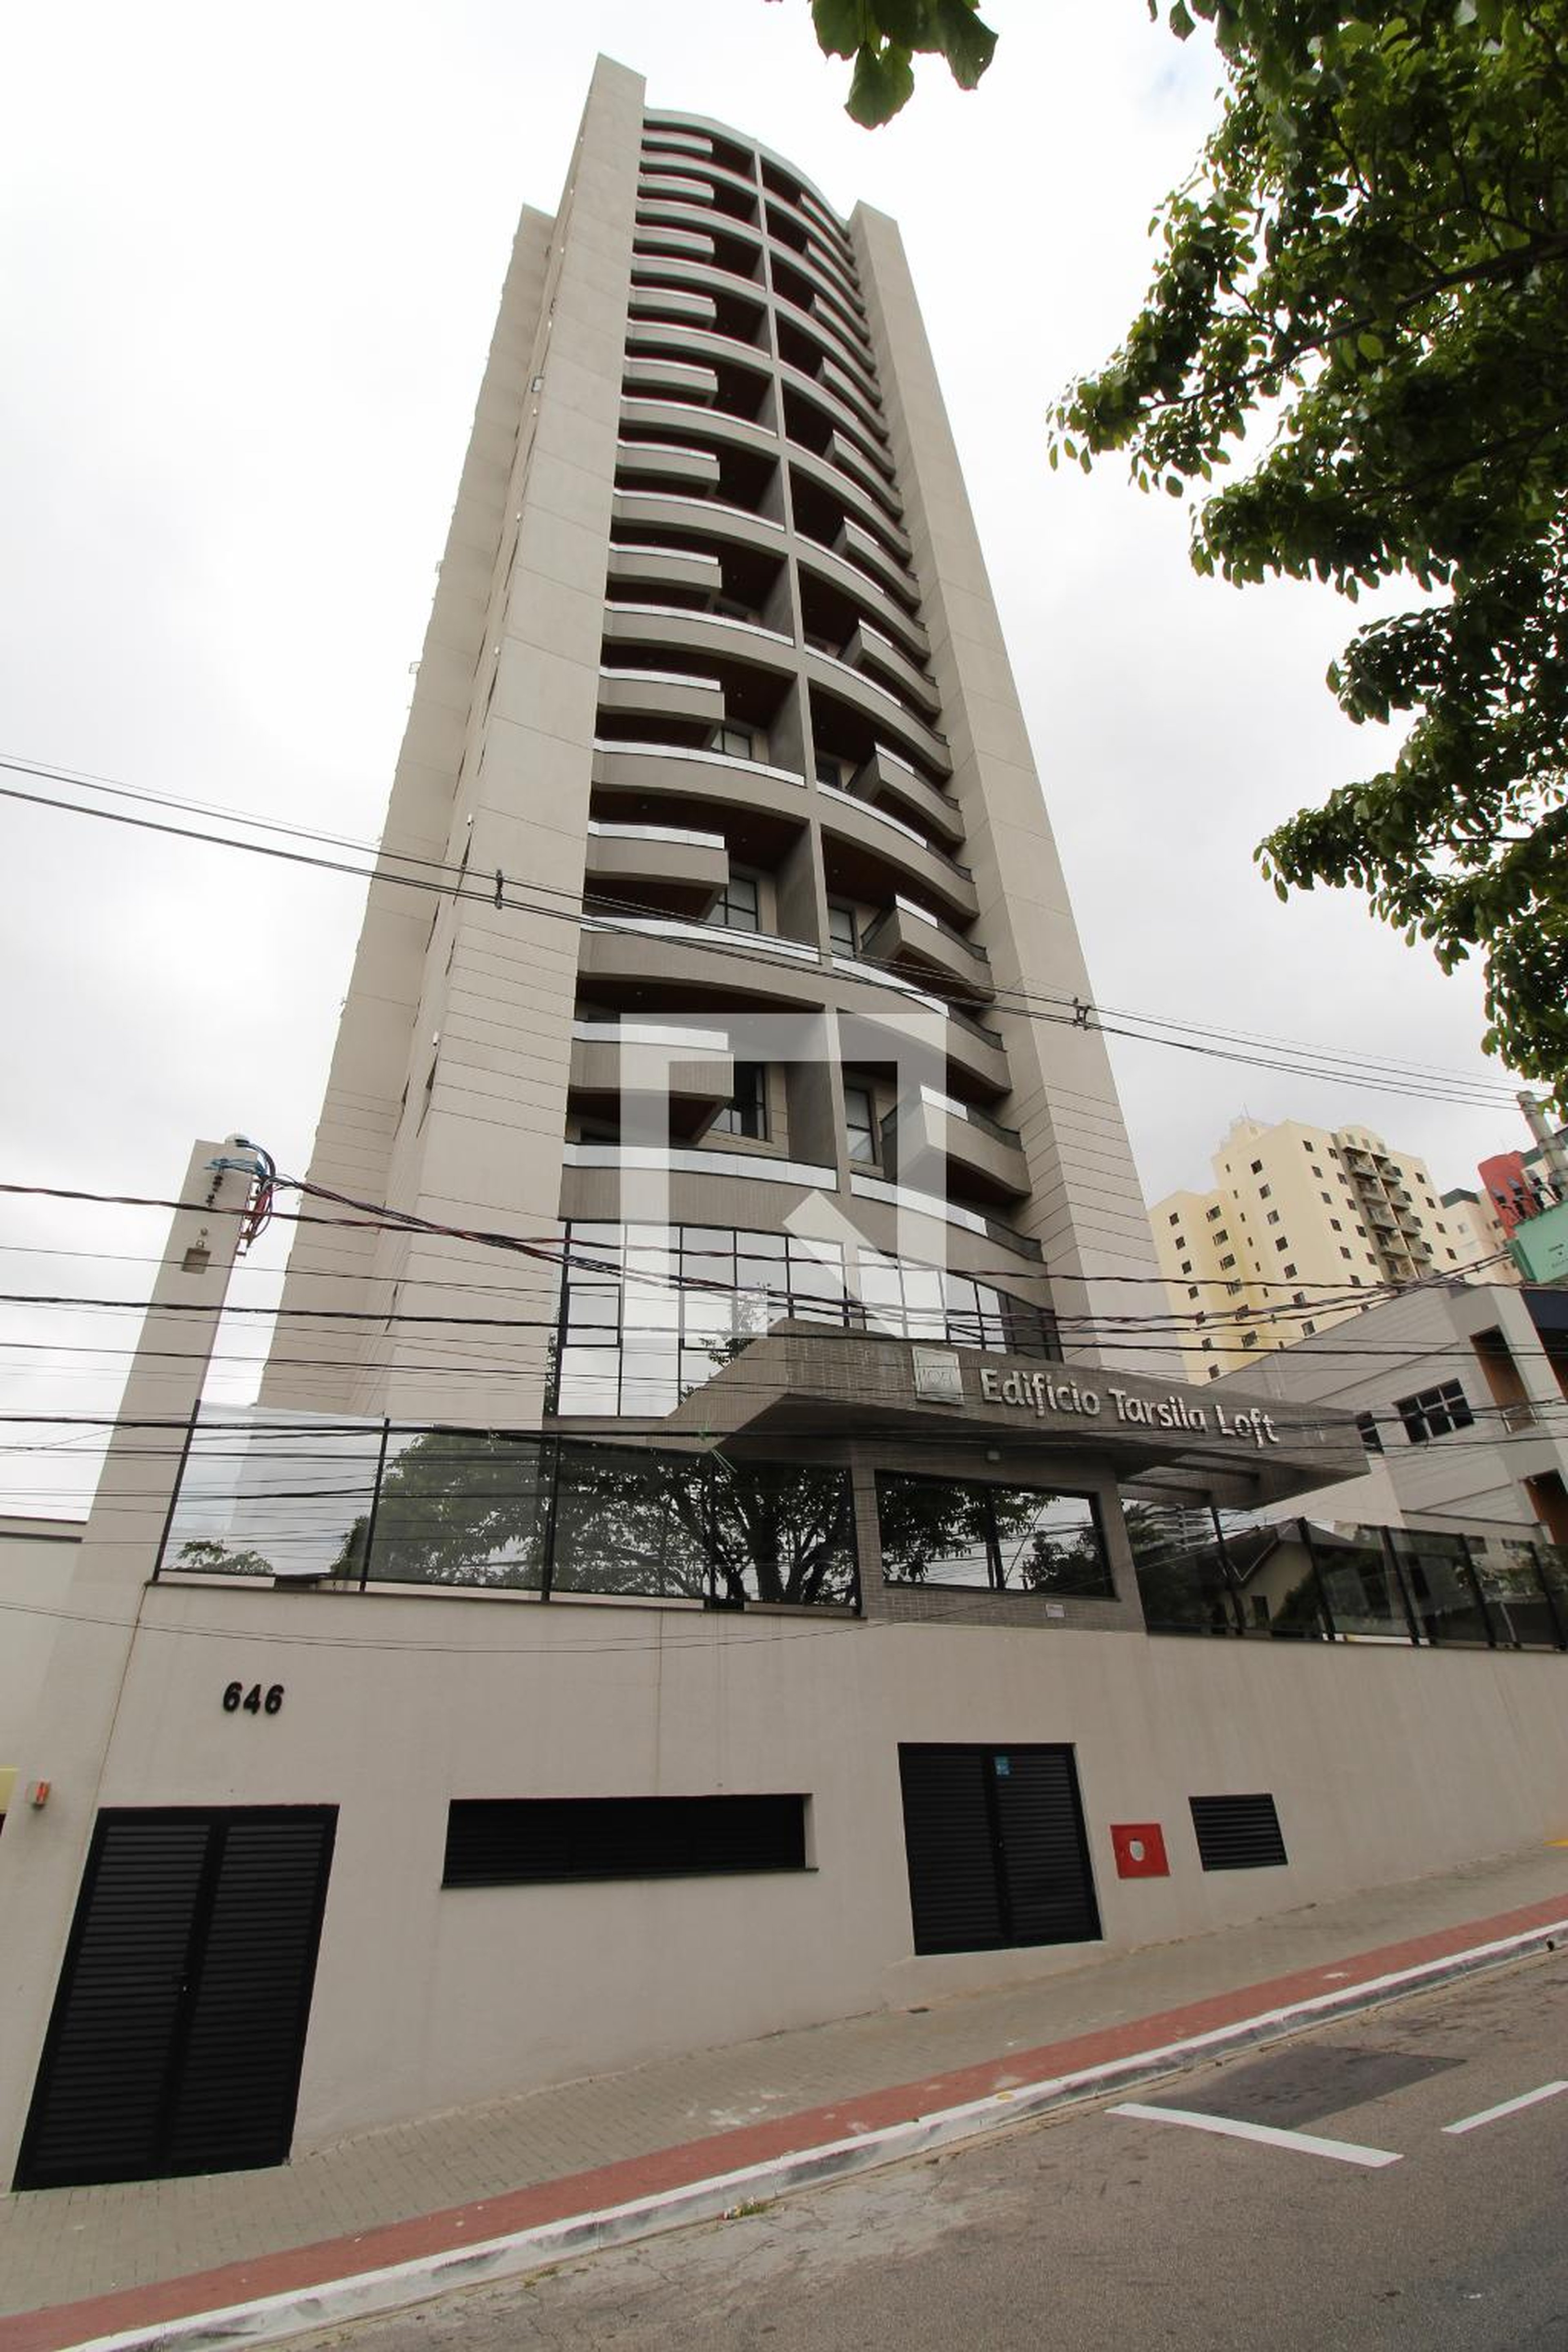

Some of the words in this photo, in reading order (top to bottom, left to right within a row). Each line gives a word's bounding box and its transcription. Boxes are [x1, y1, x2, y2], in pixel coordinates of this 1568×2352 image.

[1108, 1388, 1209, 1432] Tarsila
[1215, 1405, 1280, 1448] Loft
[223, 1681, 285, 1715] 646
